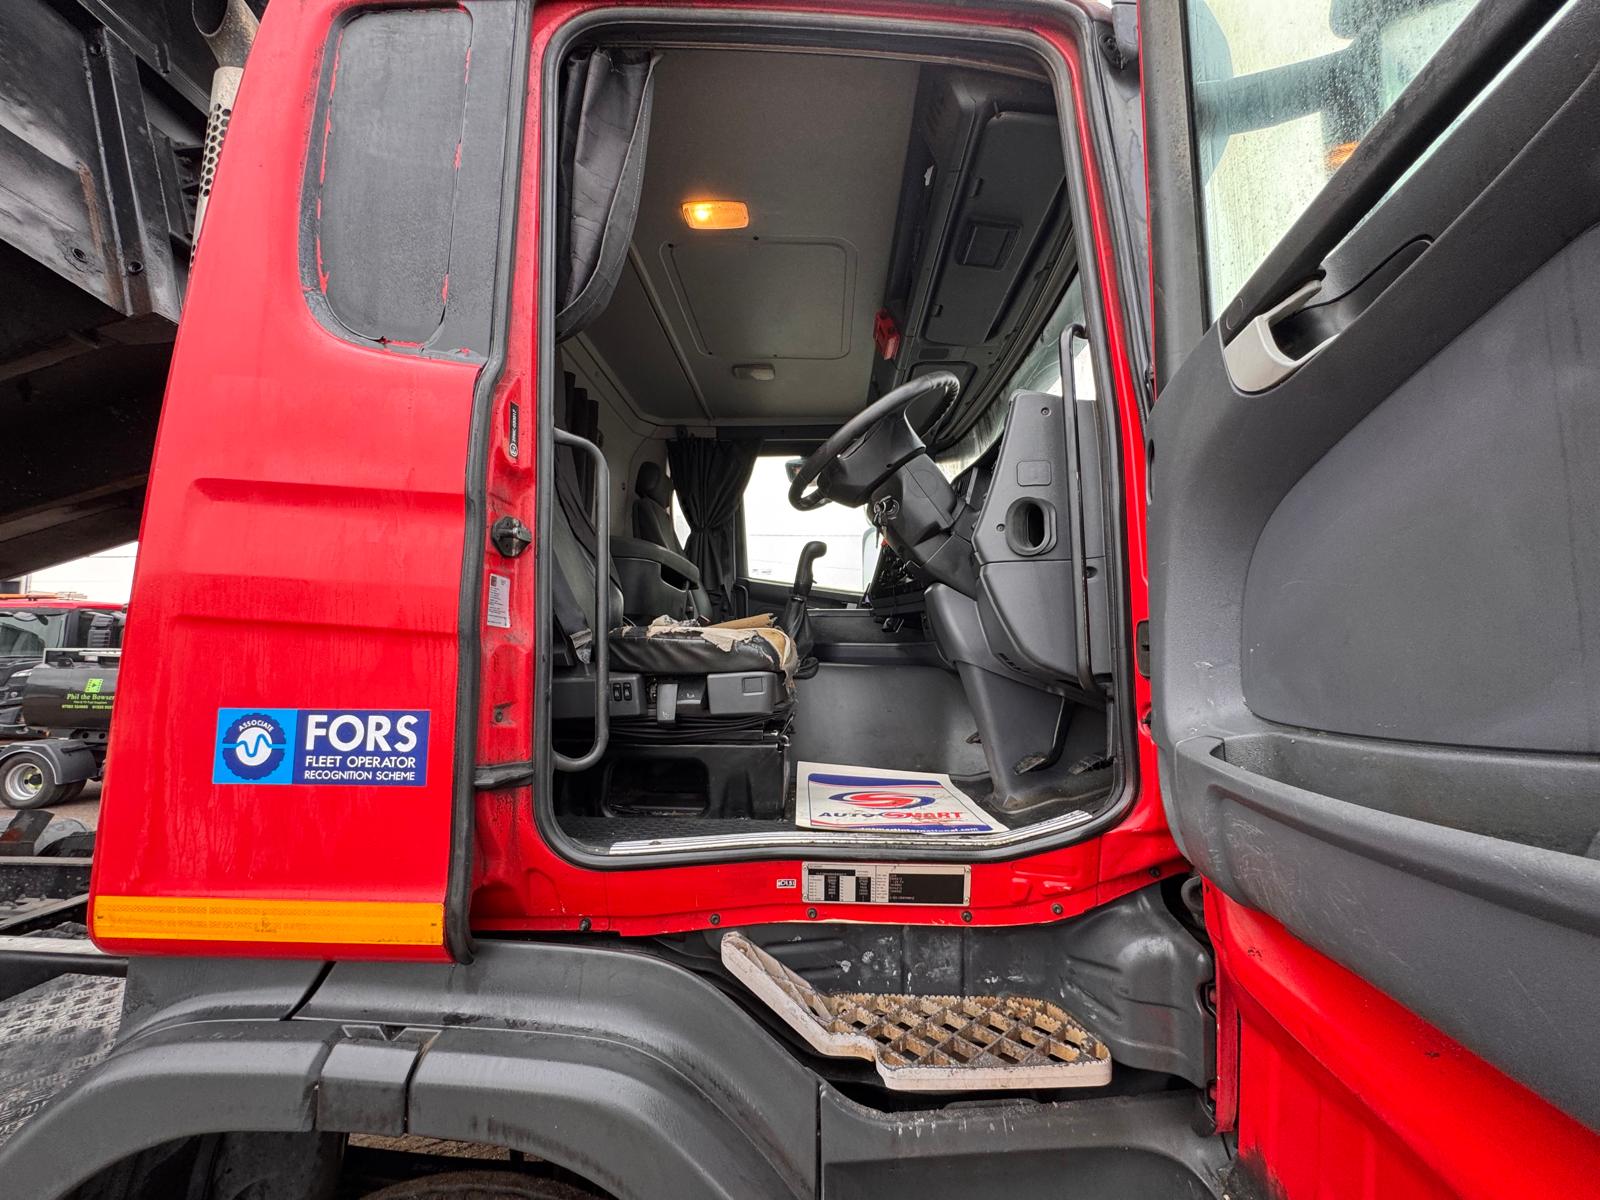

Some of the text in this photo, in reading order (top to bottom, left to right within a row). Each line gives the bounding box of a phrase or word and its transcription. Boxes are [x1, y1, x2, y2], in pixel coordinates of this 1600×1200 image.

[239, 719, 275, 732] ASSOCIATE
[305, 714, 419, 753] FORS
[305, 755, 416, 769] FLEET OPERATOR
[304, 770, 416, 781] RECOGNITION SCHEME
